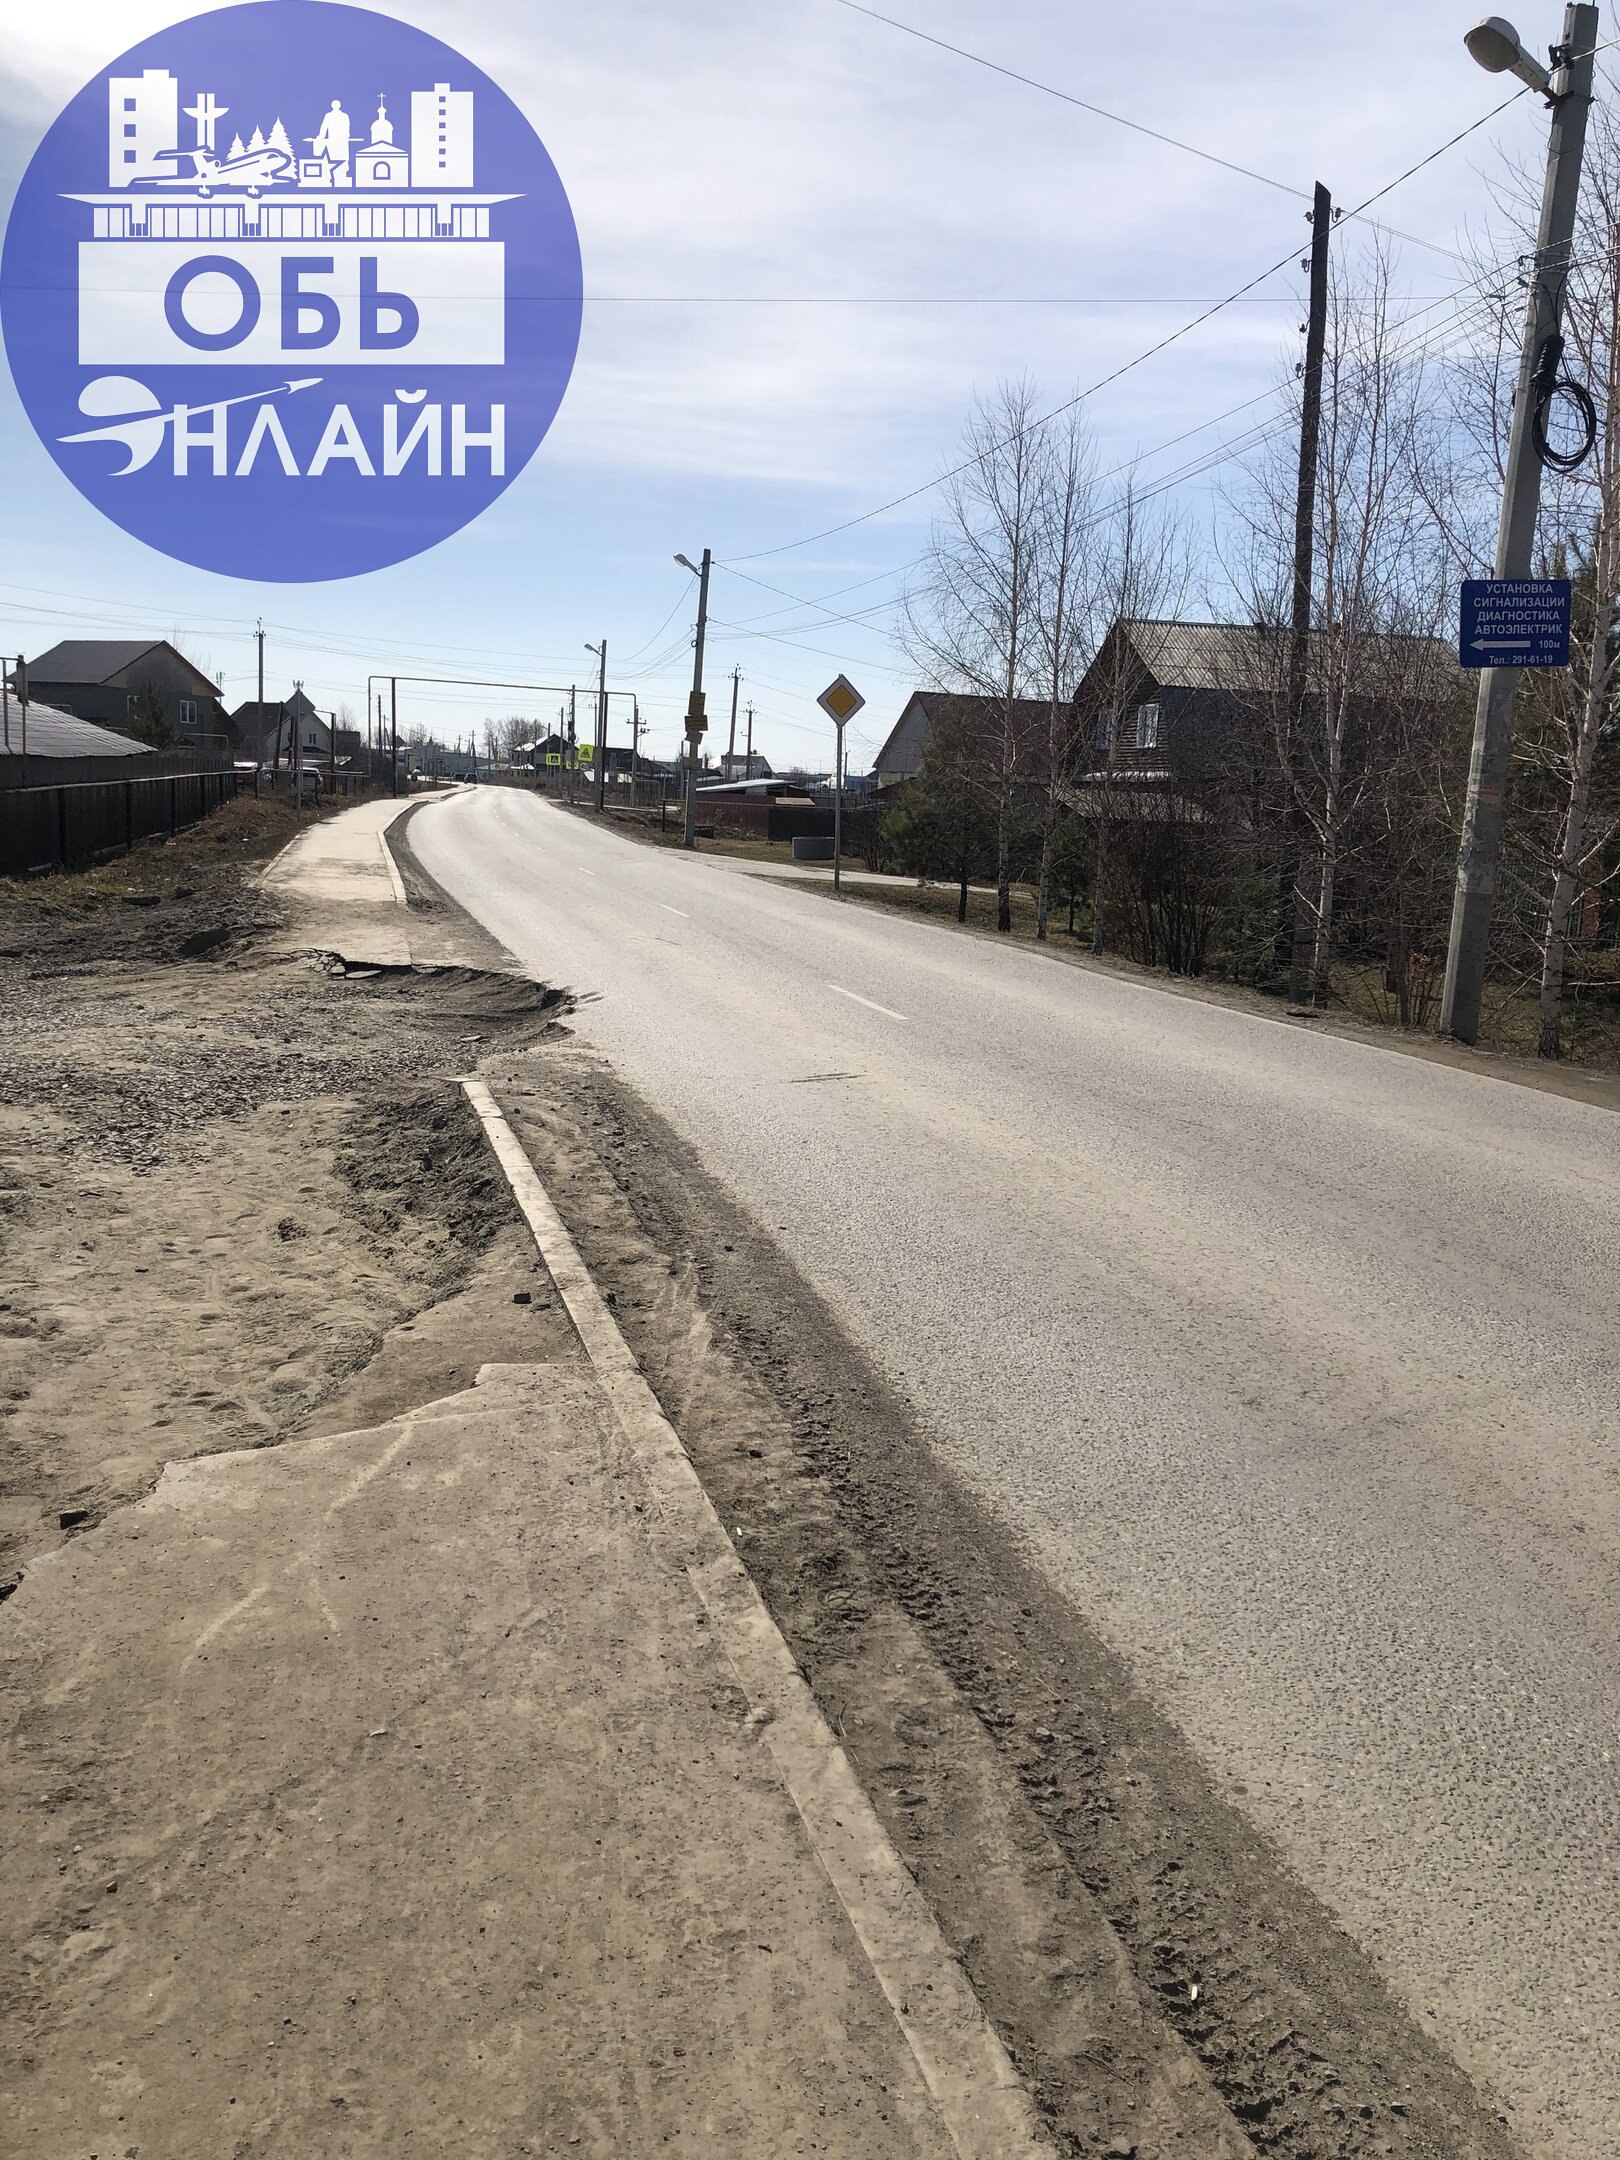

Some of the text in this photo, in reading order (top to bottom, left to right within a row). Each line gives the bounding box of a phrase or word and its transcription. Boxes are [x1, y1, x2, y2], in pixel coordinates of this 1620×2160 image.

[1486, 583, 1553, 594] УСТАНОВКА
[1473, 597, 1565, 608] СИГНАЛИЗАЦИИ
[1477, 610, 1560, 622] ДИАГНОСТИКА
[1474, 624, 1563, 635] АВТОЭЛЕКТРИК
[1538, 639, 1561, 649] 100м
[1512, 655, 1553, 664] 291-61-19
